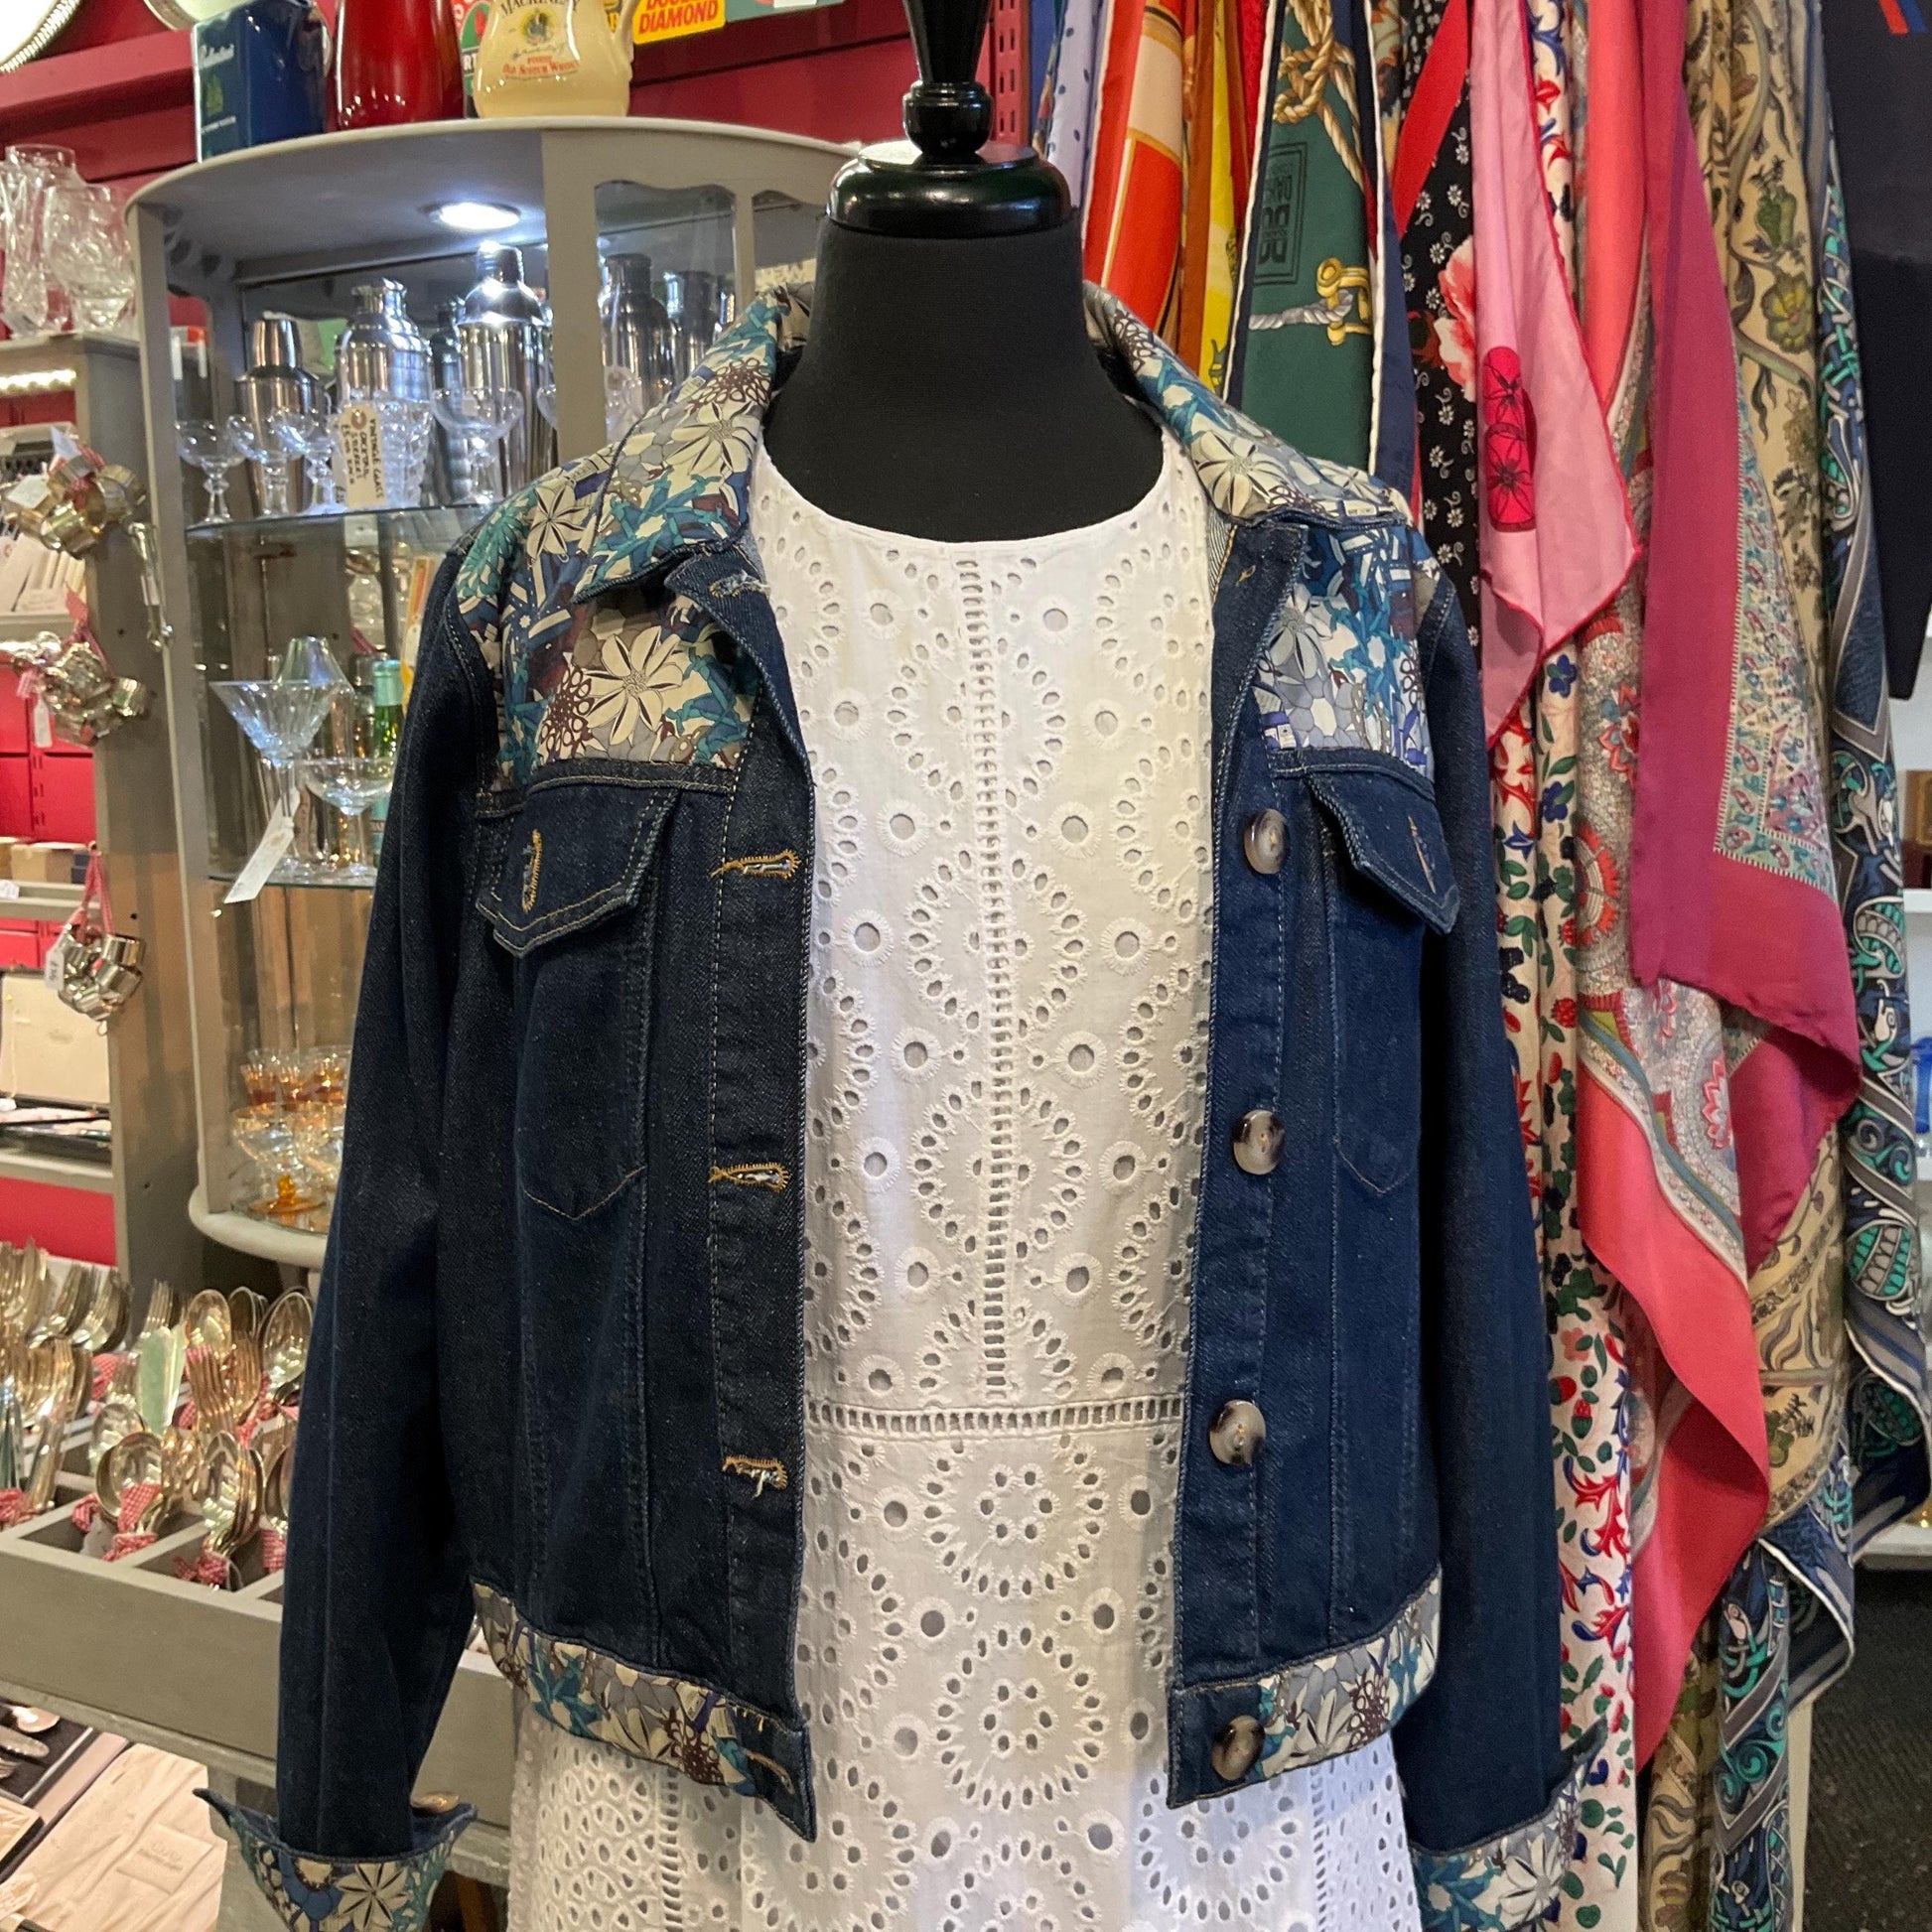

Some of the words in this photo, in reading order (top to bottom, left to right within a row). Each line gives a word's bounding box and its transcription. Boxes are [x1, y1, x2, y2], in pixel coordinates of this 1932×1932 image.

[638, 0, 719, 34] DIAMOND
[369, 418, 381, 465] VINTAGE
[373, 468, 385, 498] GLASS
